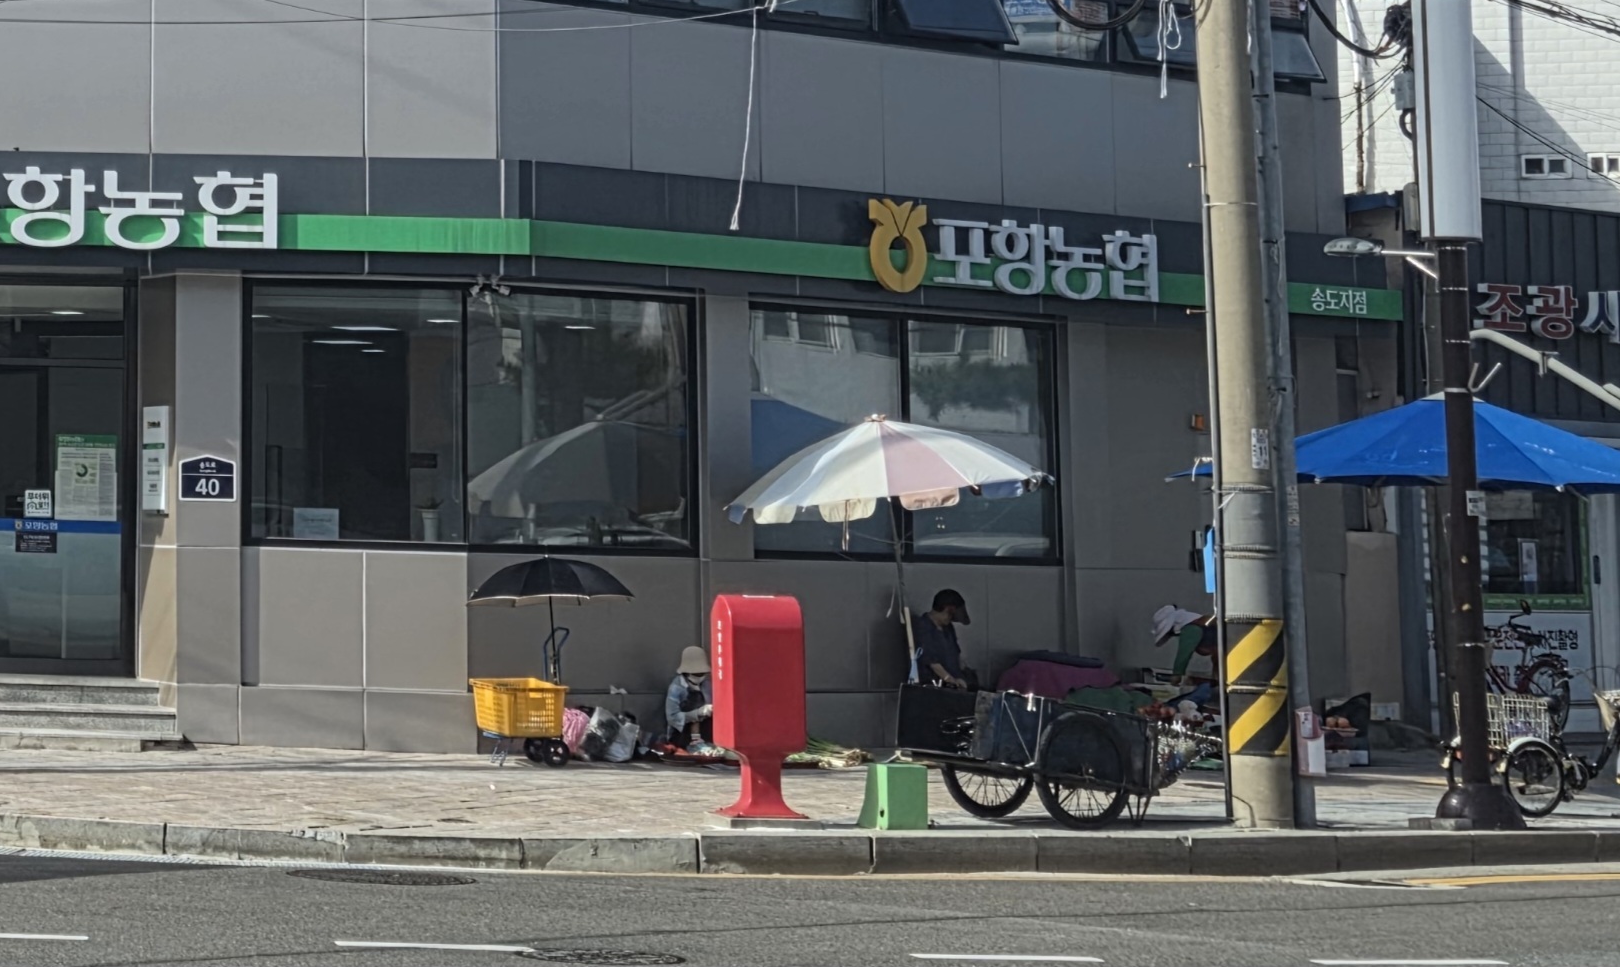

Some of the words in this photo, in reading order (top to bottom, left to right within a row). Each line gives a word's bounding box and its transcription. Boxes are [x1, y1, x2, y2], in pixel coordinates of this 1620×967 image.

[932, 219, 1159, 303] 포항농협
[1310, 285, 1367, 314] 송도지점
[195, 478, 220, 496] 40
